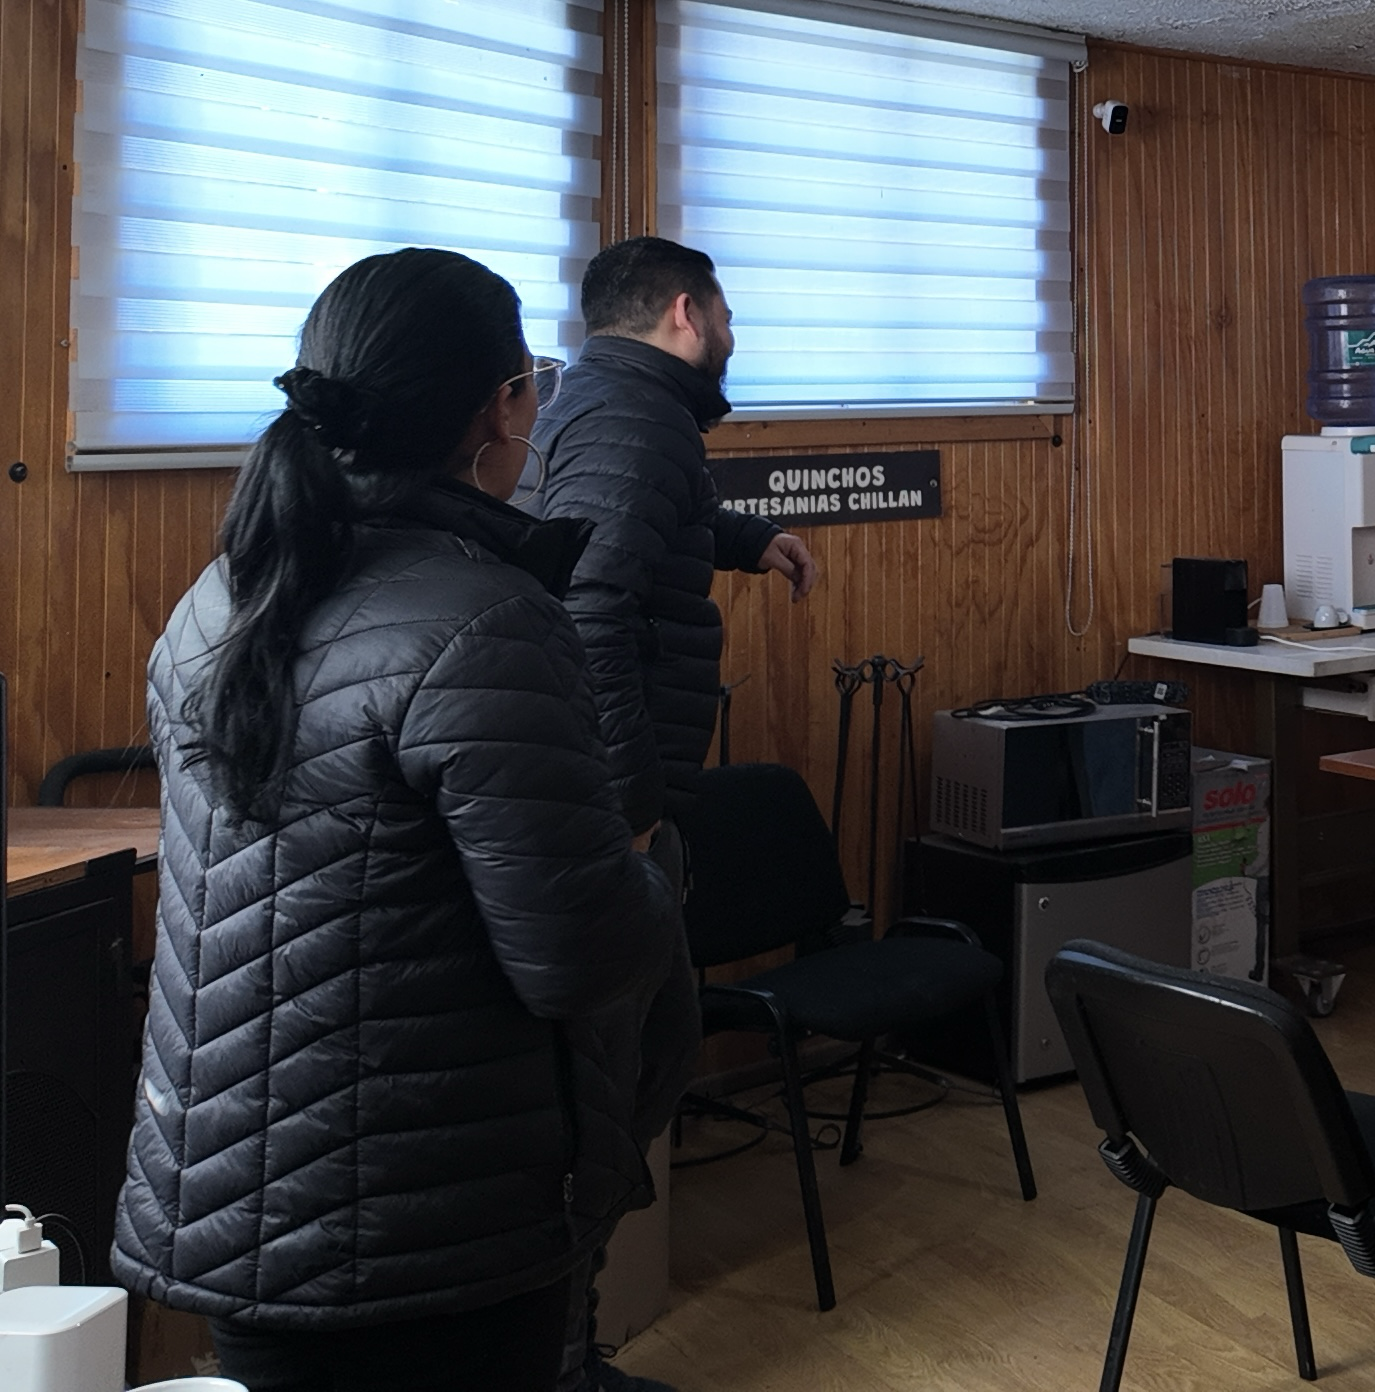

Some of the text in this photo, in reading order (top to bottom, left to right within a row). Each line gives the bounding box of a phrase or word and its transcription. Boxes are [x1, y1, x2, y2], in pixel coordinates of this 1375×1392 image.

[768, 465, 886, 494] QUINCHOS
[721, 489, 923, 517] ARTESANIAS CHILLAN
[1203, 781, 1257, 811] solo
